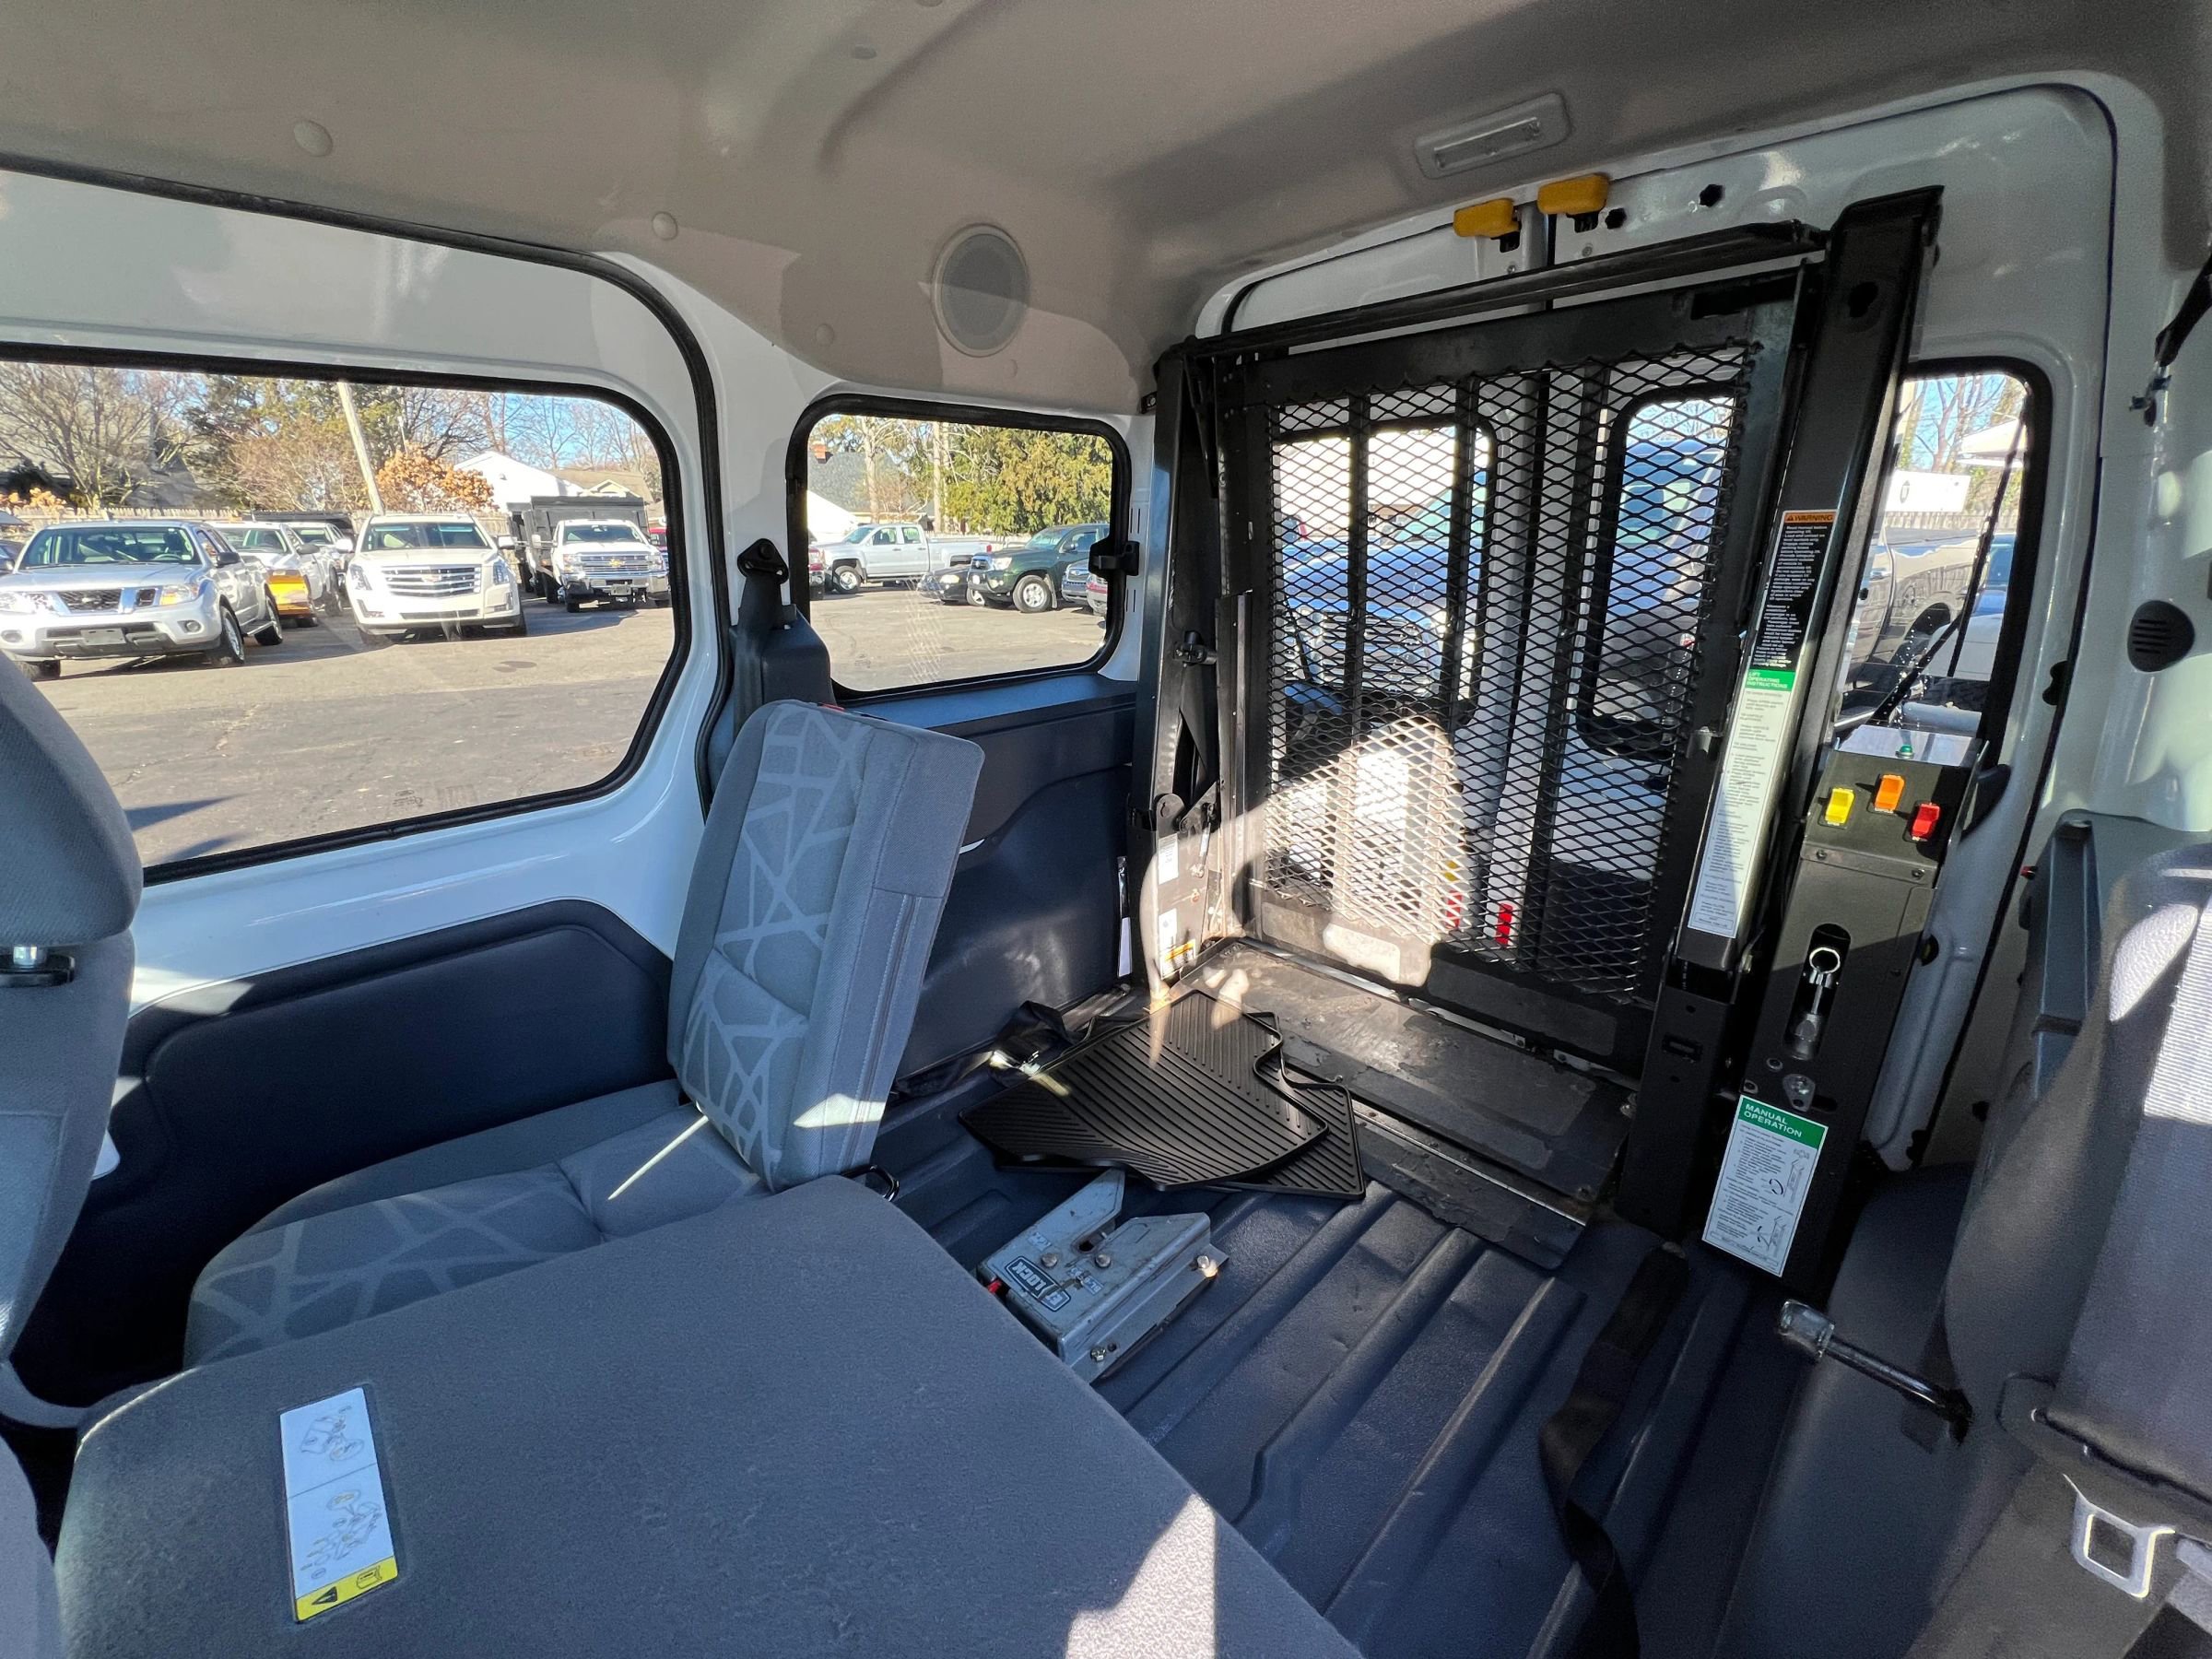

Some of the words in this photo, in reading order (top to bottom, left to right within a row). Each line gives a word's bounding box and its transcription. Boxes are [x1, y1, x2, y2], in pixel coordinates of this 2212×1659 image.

[1743, 1111, 1803, 1138] OPERATION
[1745, 1103, 1788, 1125] MANUAL
[1012, 1261, 1047, 1291] LOCK
